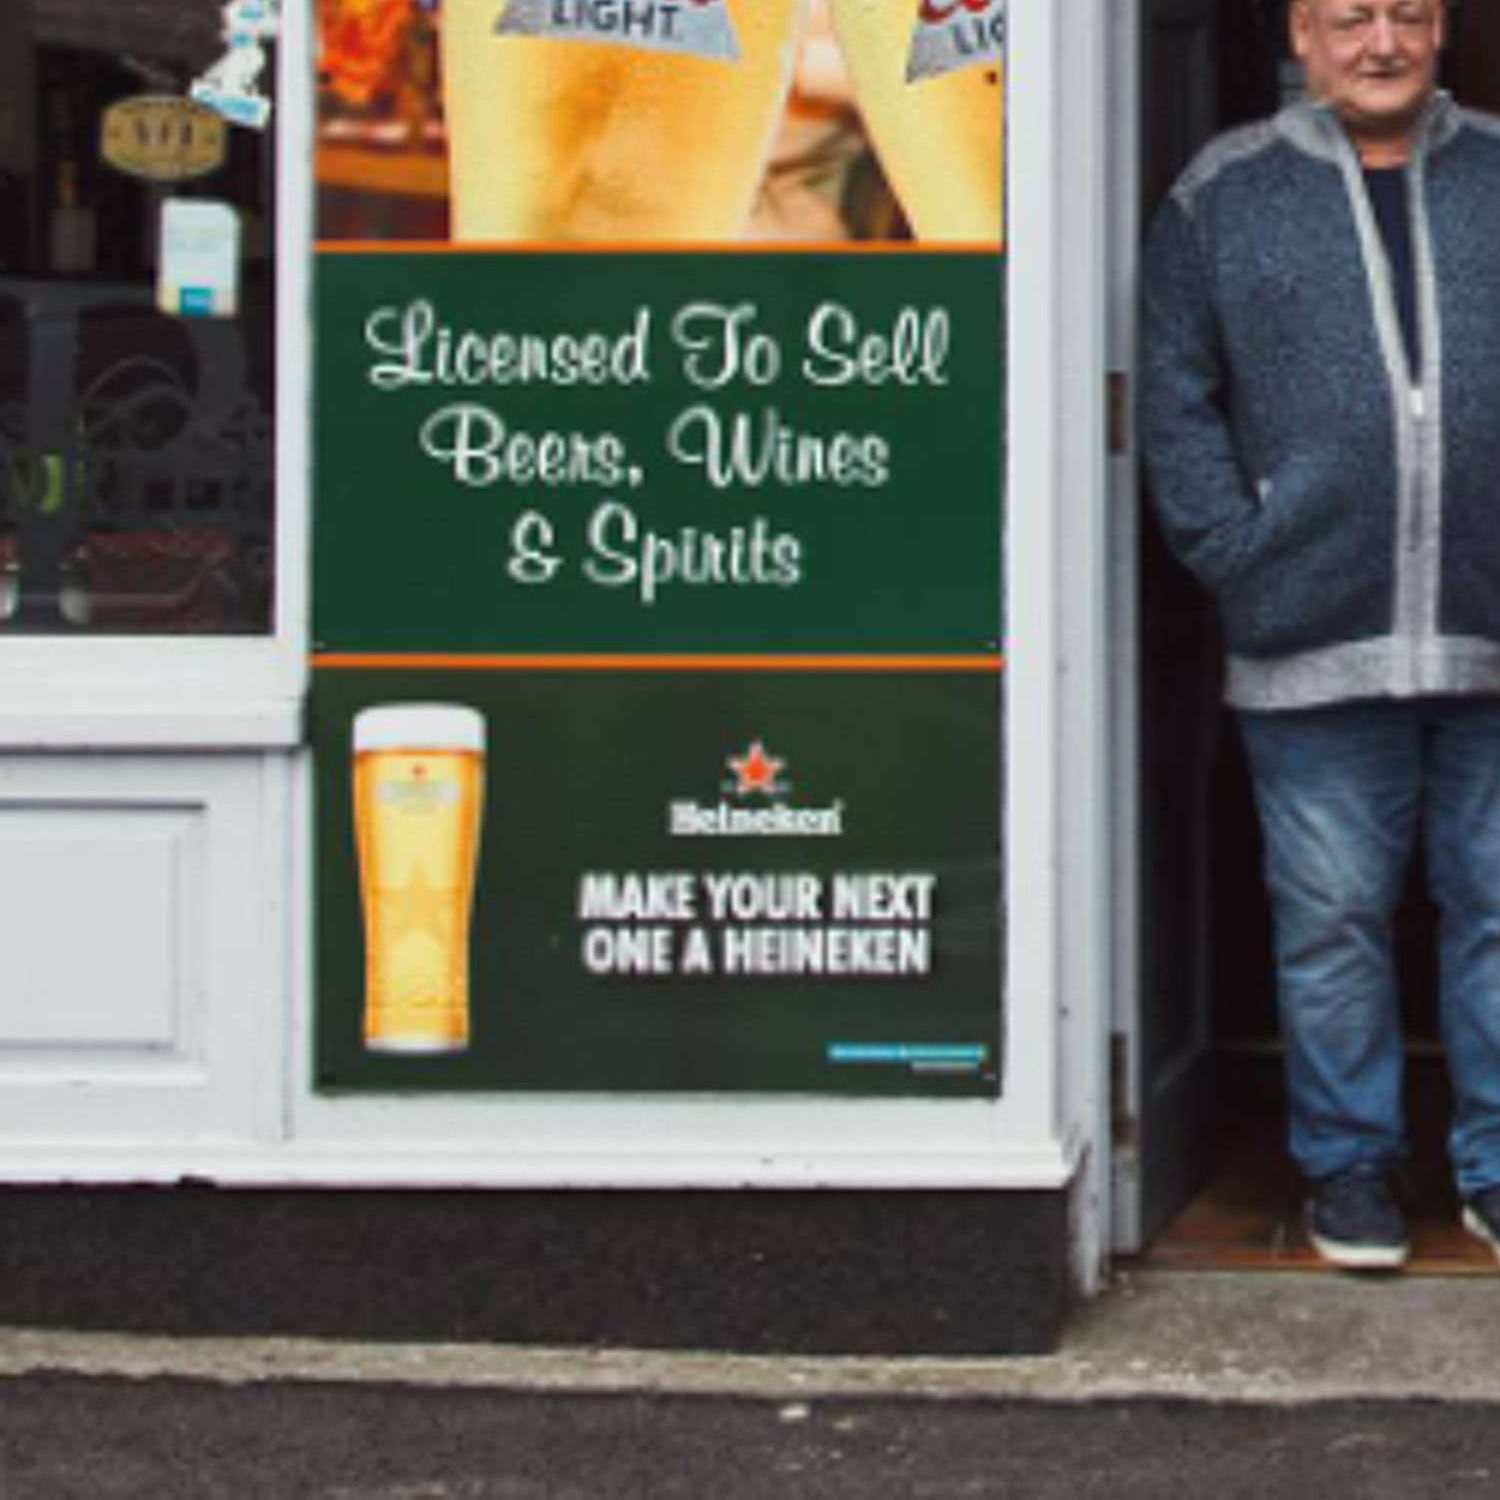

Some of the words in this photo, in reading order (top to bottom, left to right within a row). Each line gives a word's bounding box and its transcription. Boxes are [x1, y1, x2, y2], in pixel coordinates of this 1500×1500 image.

[364, 299, 651, 390] Licensed
[671, 302, 781, 390] To
[802, 302, 950, 386] Sell
[668, 404, 890, 489] Wines
[507, 509, 563, 583] &
[583, 500, 802, 604] Spirits
[670, 799, 842, 836] Heineken
[577, 873, 697, 920] MAKE
[703, 873, 823, 921] YOUR
[831, 873, 937, 921] NEXT
[582, 926, 673, 974] ONE
[681, 927, 713, 973] A
[723, 926, 931, 974] HEINEKEN
